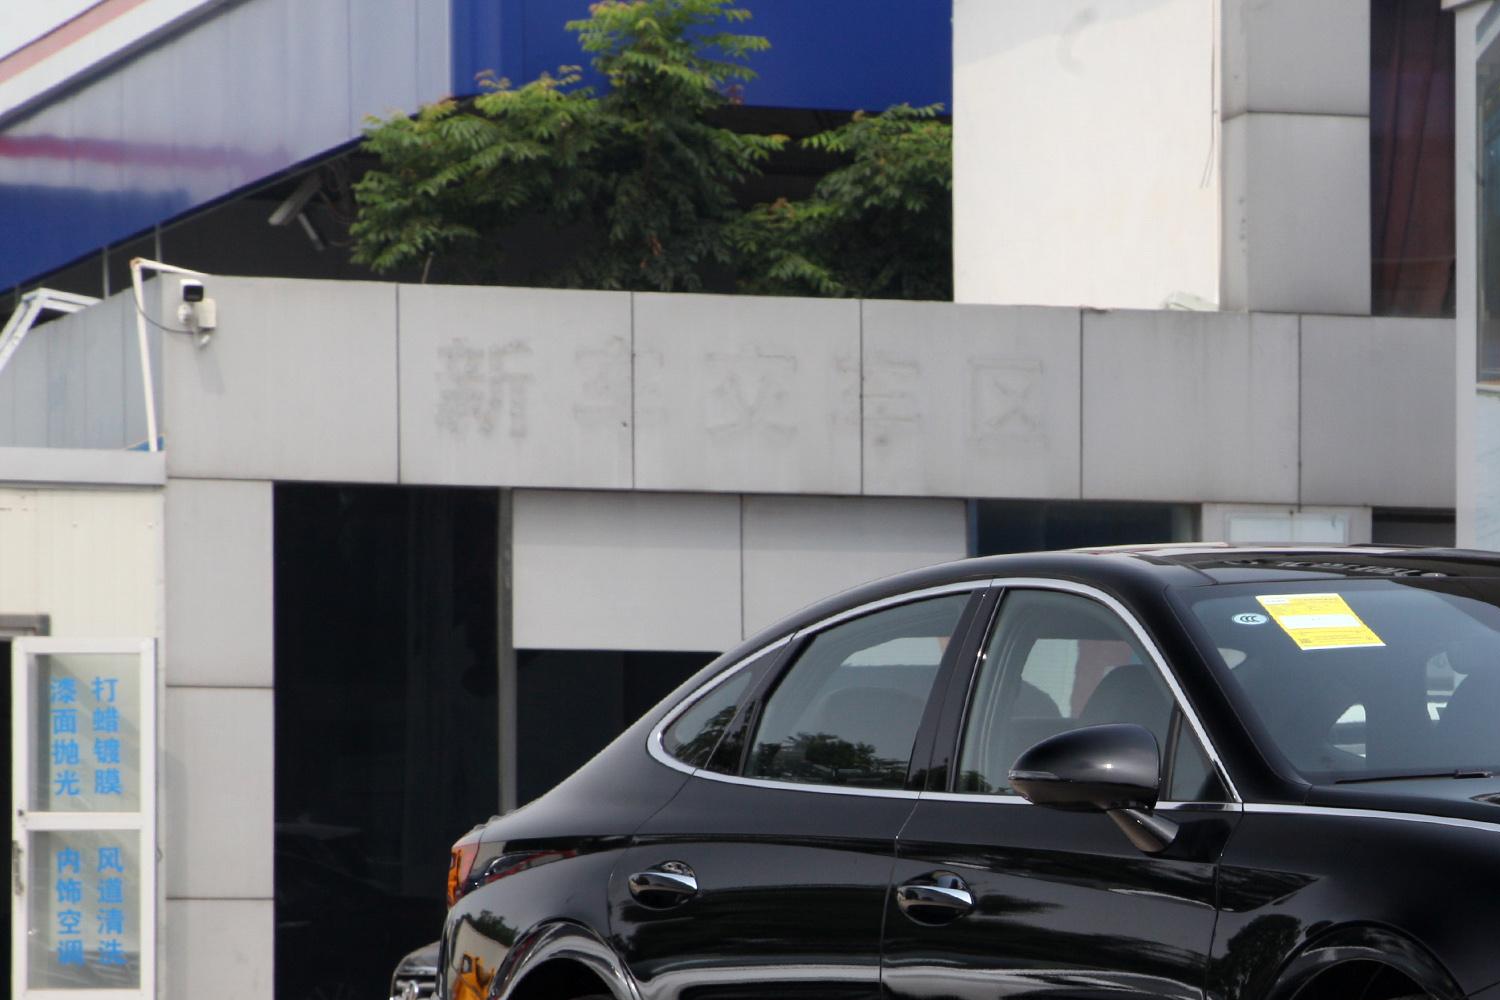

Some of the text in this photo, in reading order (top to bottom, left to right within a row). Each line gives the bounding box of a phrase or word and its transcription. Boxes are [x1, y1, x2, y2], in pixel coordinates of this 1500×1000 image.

[91, 676, 122, 796] 打蜡镀膜
[96, 847, 127, 966] 风道清洗
